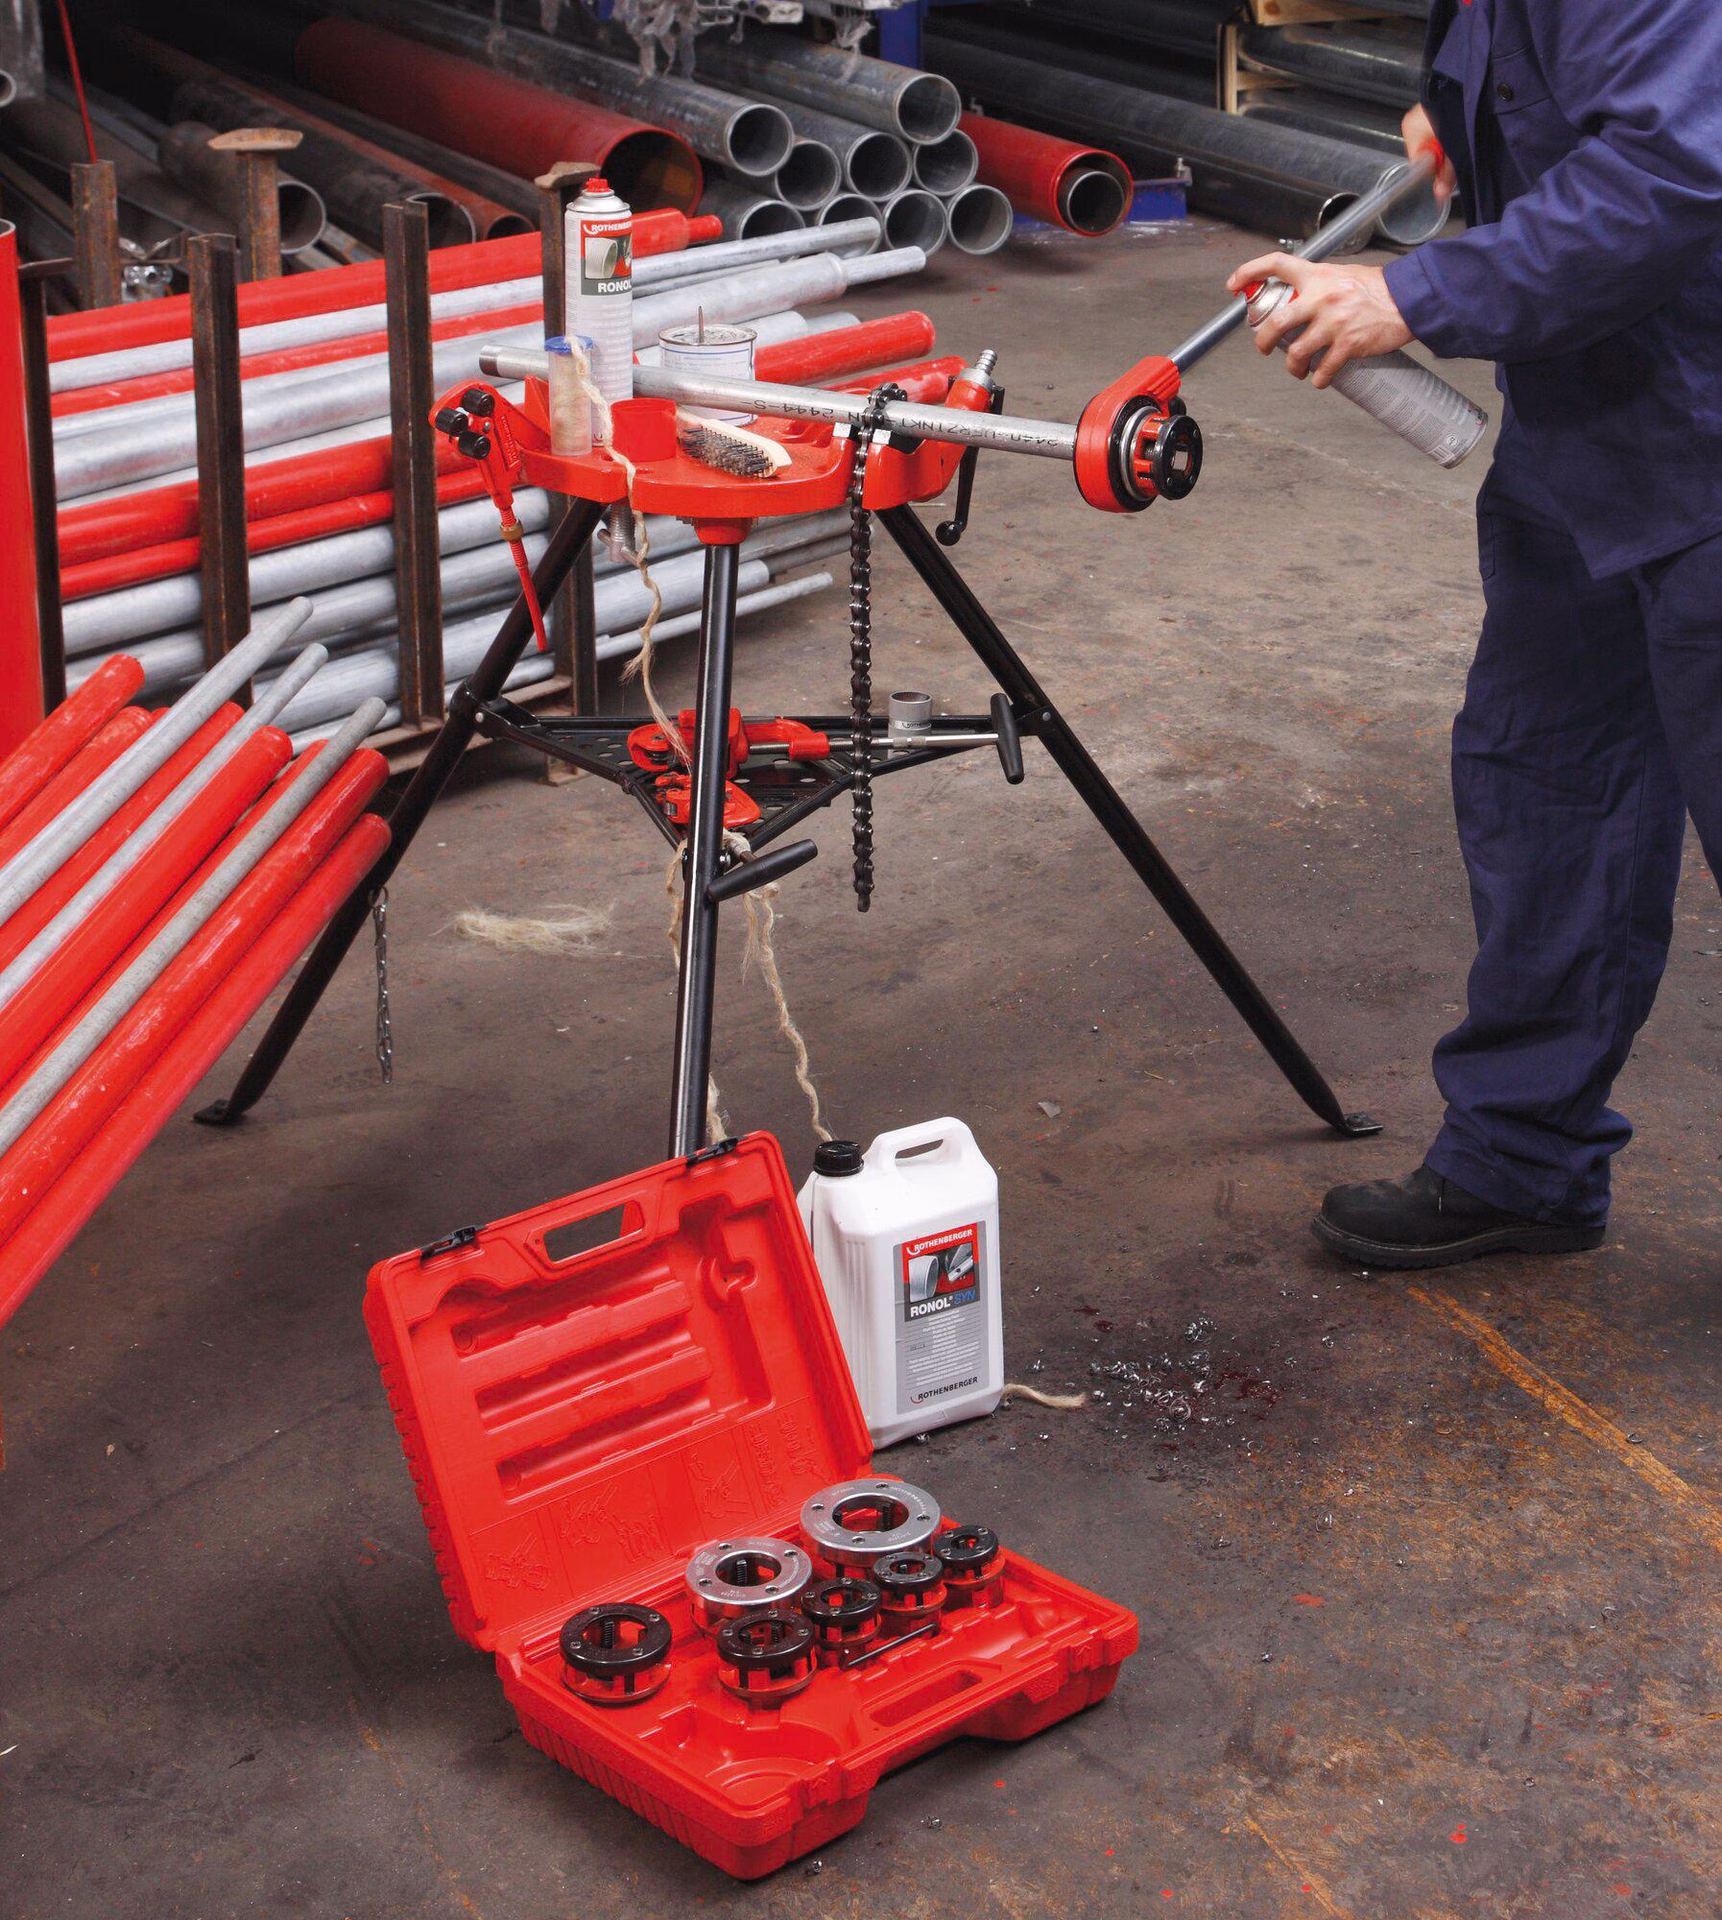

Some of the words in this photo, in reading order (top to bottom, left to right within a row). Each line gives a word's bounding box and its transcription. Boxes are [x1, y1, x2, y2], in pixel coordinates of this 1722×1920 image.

[914, 1229, 973, 1251] ROTHENBERGER
[954, 1290, 976, 1305] SYN
[917, 1376, 978, 1400] ROTHENBERGER
